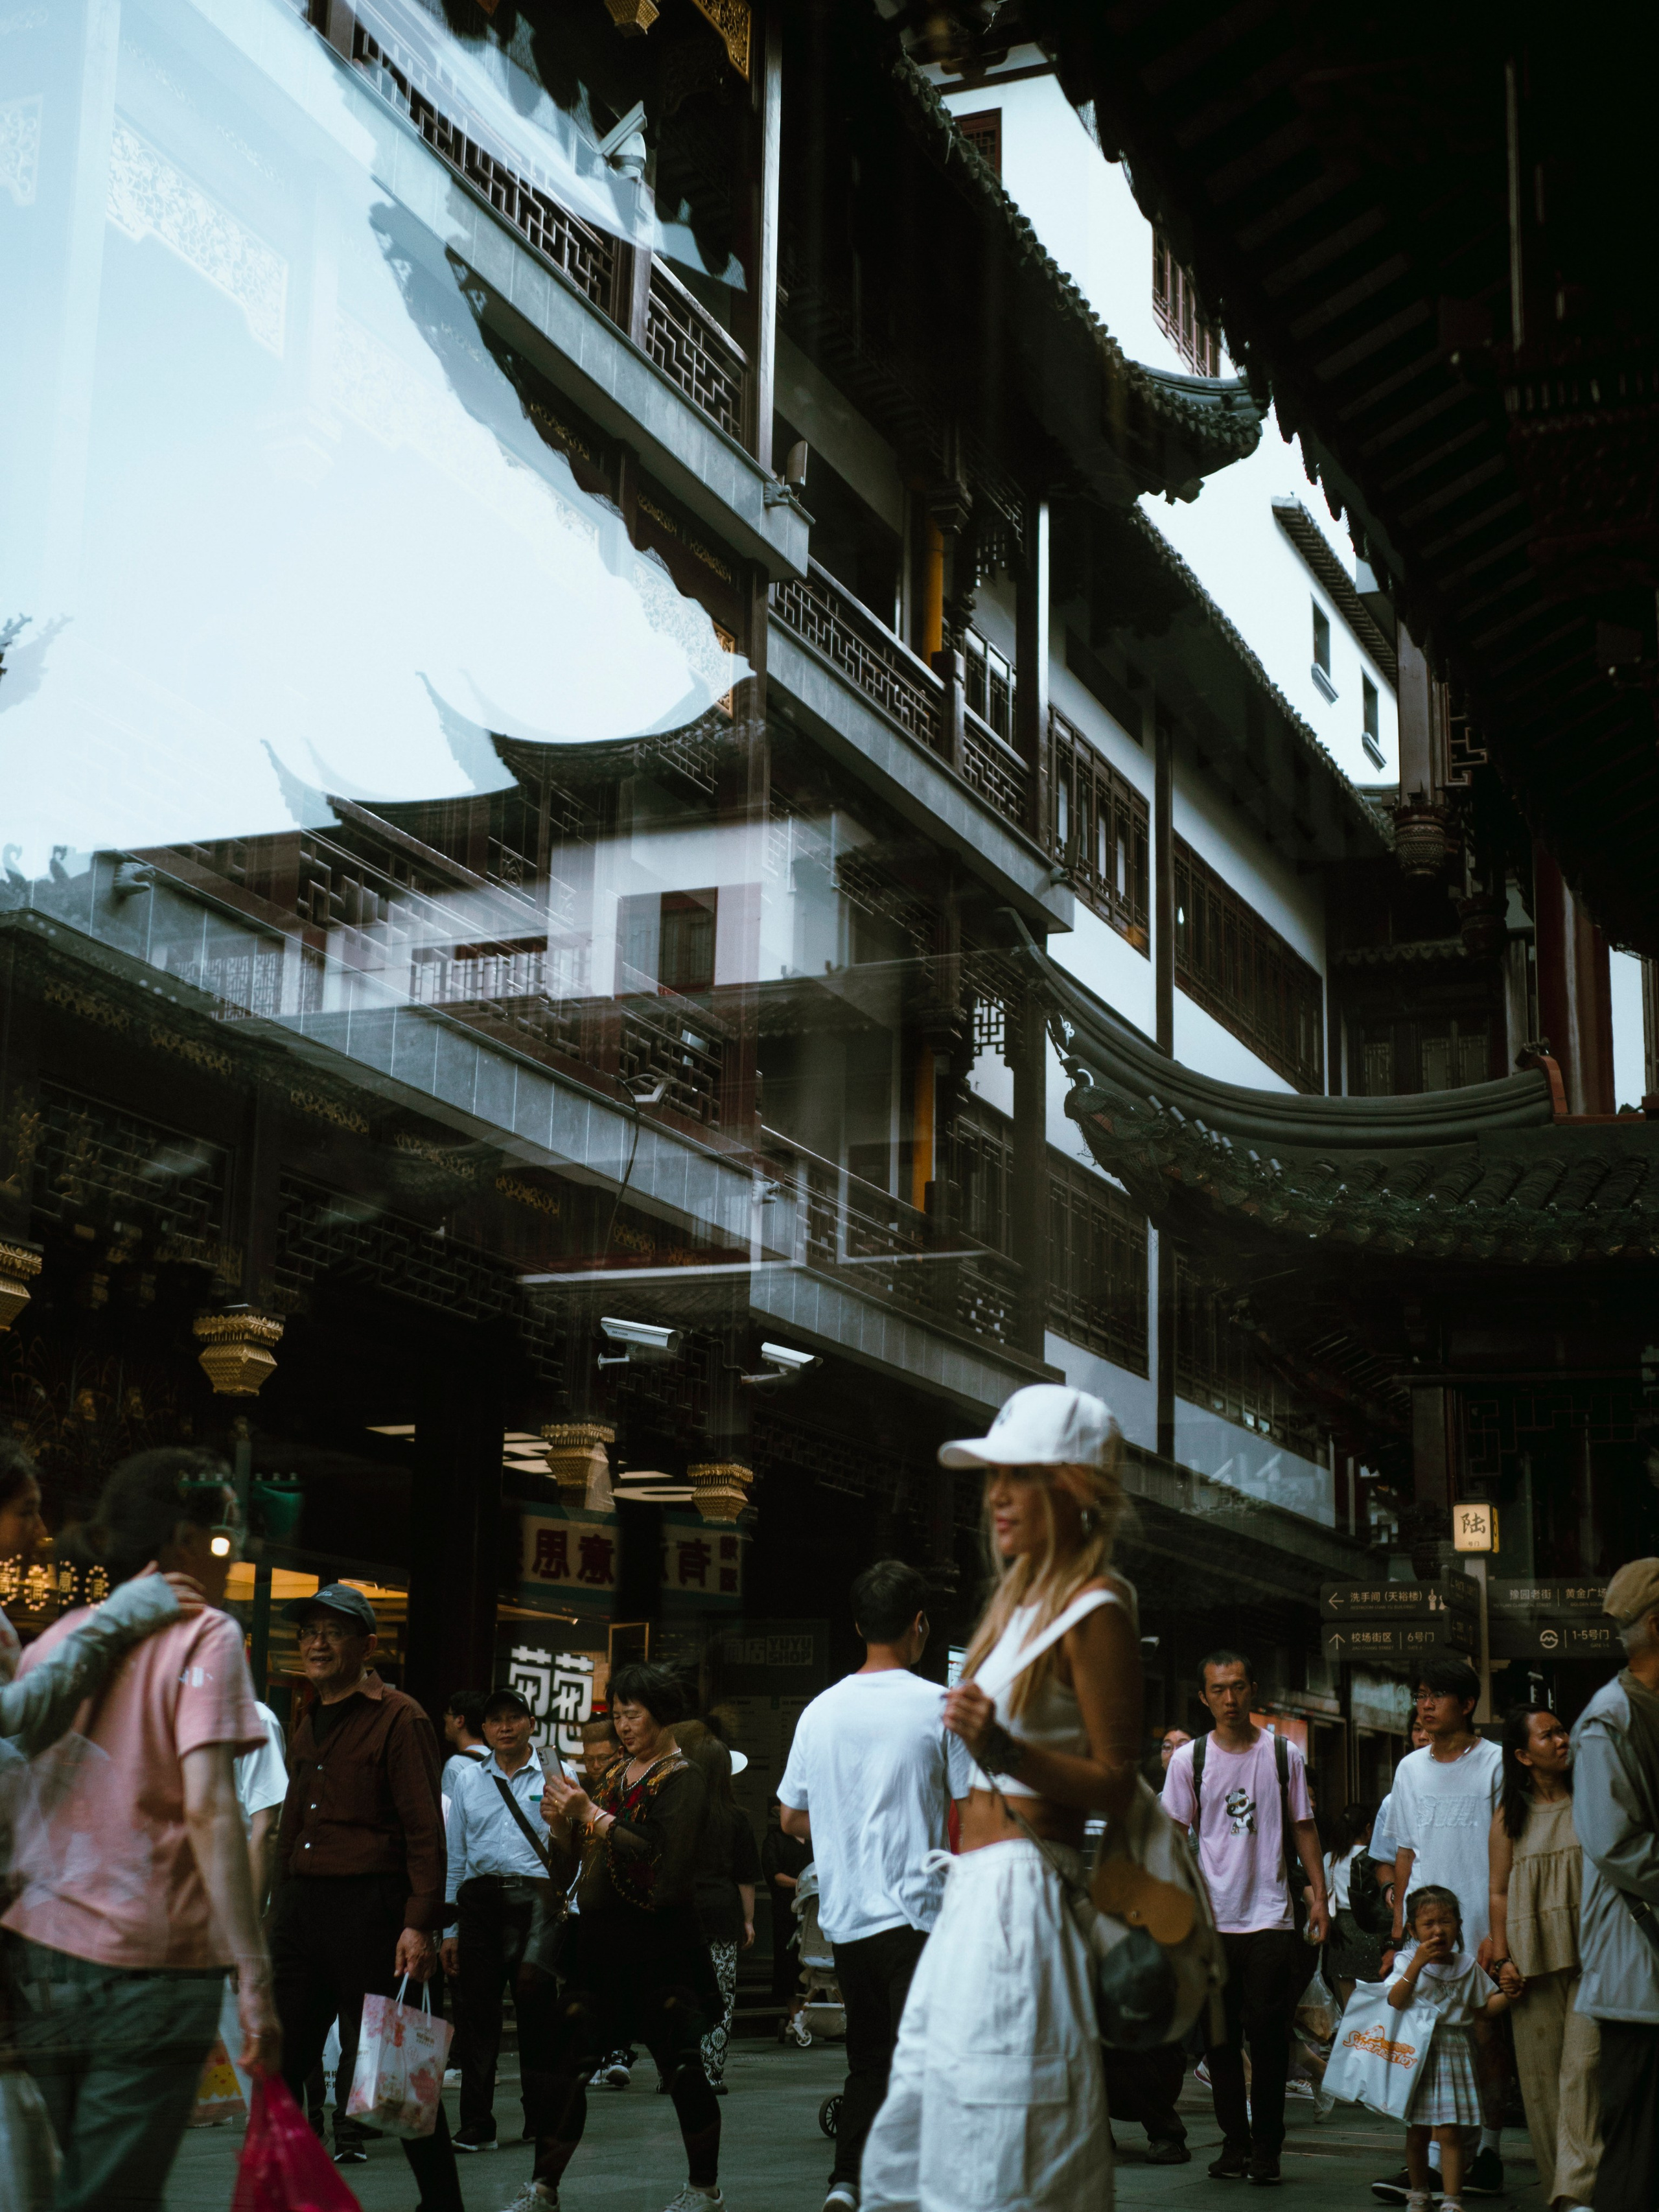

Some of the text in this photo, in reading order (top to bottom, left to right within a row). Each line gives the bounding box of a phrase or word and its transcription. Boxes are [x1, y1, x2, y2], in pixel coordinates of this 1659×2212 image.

[1461, 1511, 1486, 1534] 陆
[1350, 1591, 1381, 1602] 洗手间
[1509, 1589, 1551, 1600] 豫园老街
[1566, 1587, 1607, 1600] 黄金广场
[1351, 1632, 1392, 1642] 校场街区
[1408, 1631, 1434, 1642] 6号门
[1572, 1629, 1609, 1640] 1-5号门
[769, 1651, 809, 1663] SHOP
